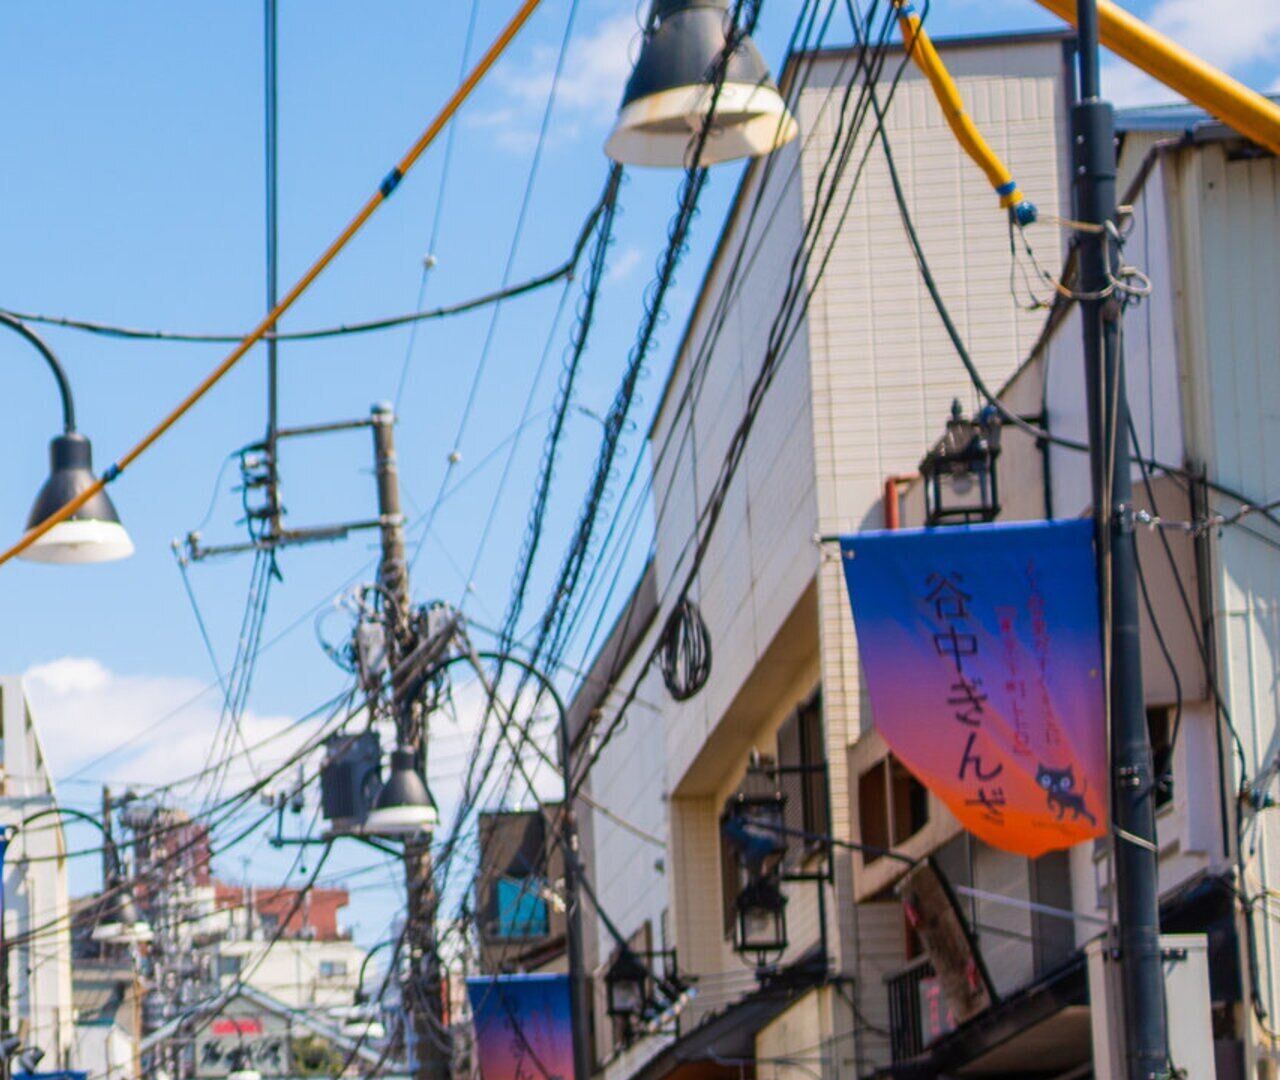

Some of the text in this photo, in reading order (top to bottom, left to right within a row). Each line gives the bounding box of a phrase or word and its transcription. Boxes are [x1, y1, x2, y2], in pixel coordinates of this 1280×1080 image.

[924, 572, 1006, 826] 谷中ぎんざ
